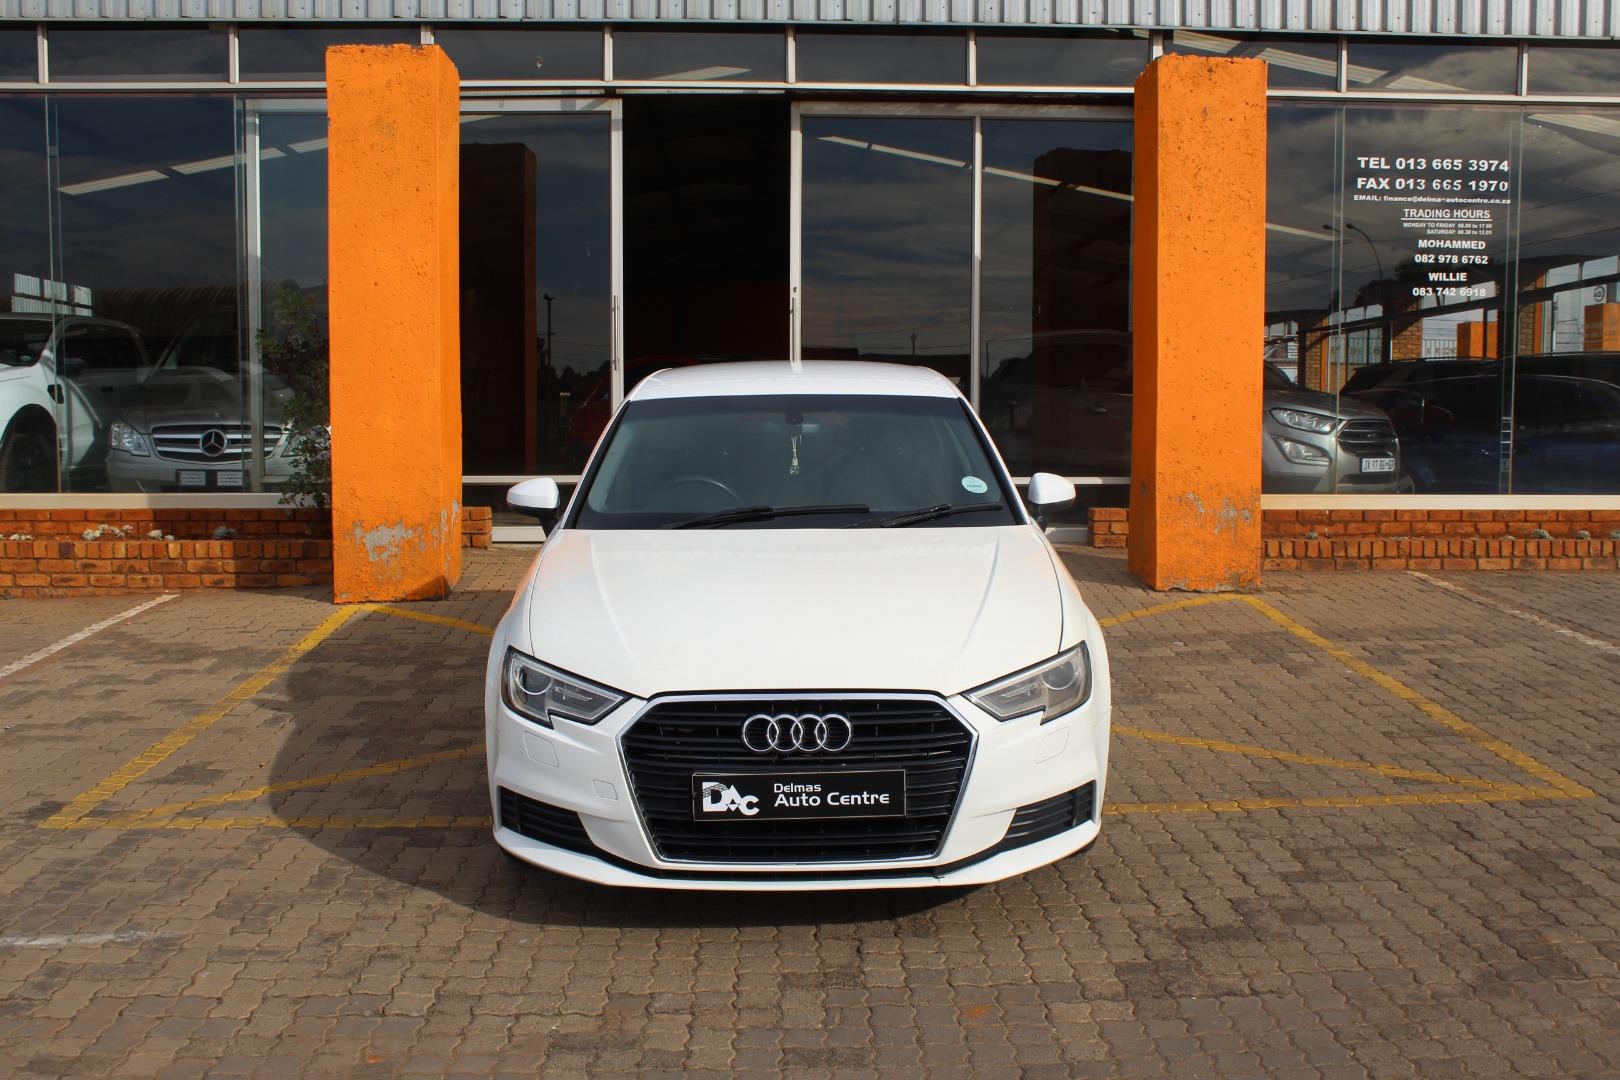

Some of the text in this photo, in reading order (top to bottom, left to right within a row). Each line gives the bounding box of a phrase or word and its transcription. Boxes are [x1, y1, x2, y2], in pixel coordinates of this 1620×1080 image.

[1357, 157, 1510, 172] TEL 013 665 3974
[1357, 177, 1509, 192] FAX 013 665 1970
[1353, 194, 1382, 202] EMAIL:
[1403, 208, 1490, 219] TRADING HOURS
[1418, 239, 1486, 250] MOHAMMED
[1414, 254, 1489, 265] 082 978 6762
[1428, 272, 1467, 282] WILLIE
[1412, 287, 1486, 297] 083 742 6918
[773, 783, 822, 793] Delmas
[774, 791, 890, 807] Auto Centre
